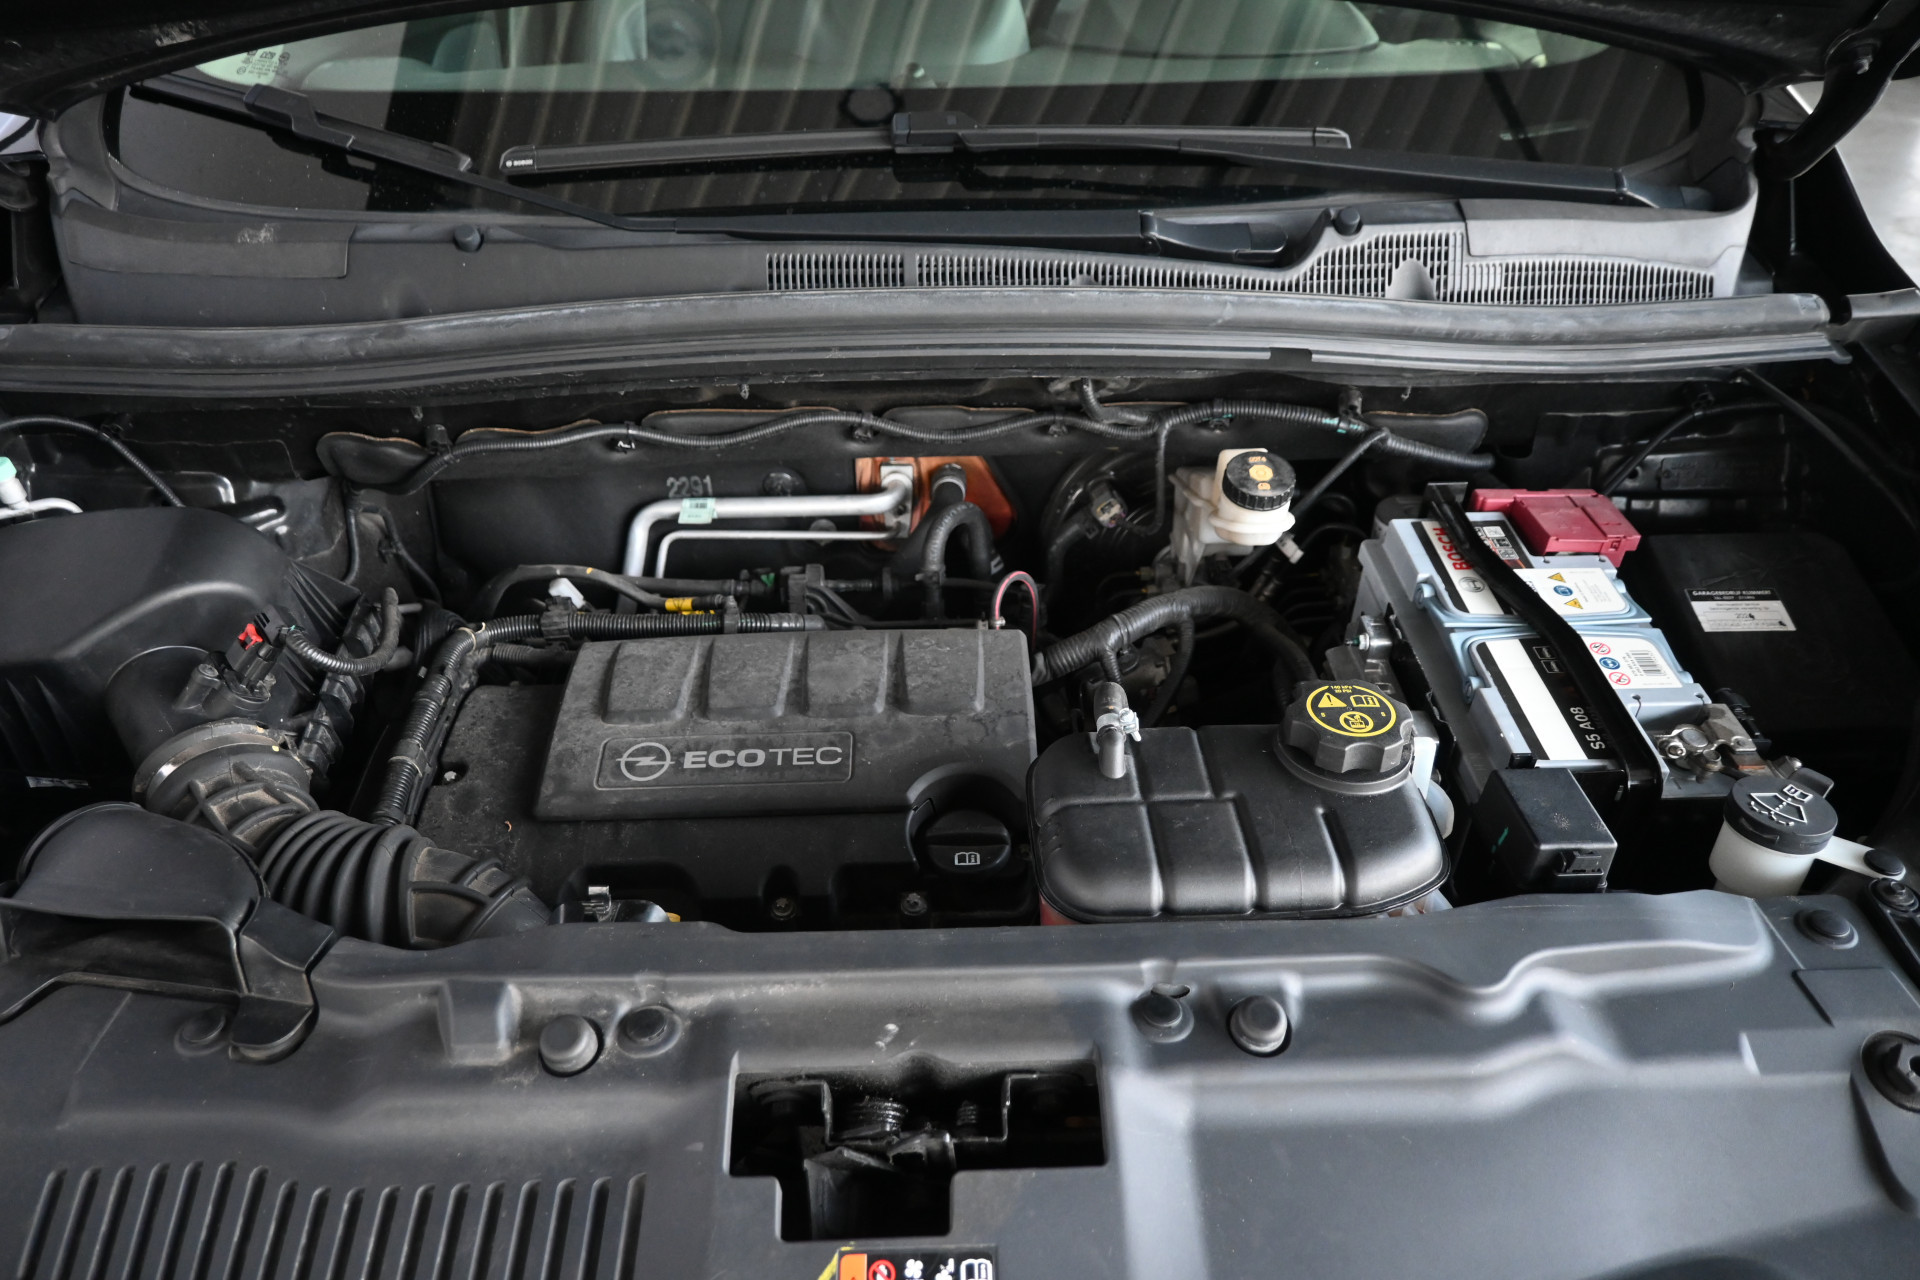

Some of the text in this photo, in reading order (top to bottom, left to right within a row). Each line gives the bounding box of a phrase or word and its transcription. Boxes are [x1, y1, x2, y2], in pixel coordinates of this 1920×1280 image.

[666, 474, 713, 498] 2291
[1433, 527, 1473, 570] BOSCH
[1569, 706, 1606, 750] S5 A08
[683, 746, 843, 769] ECOTEC
